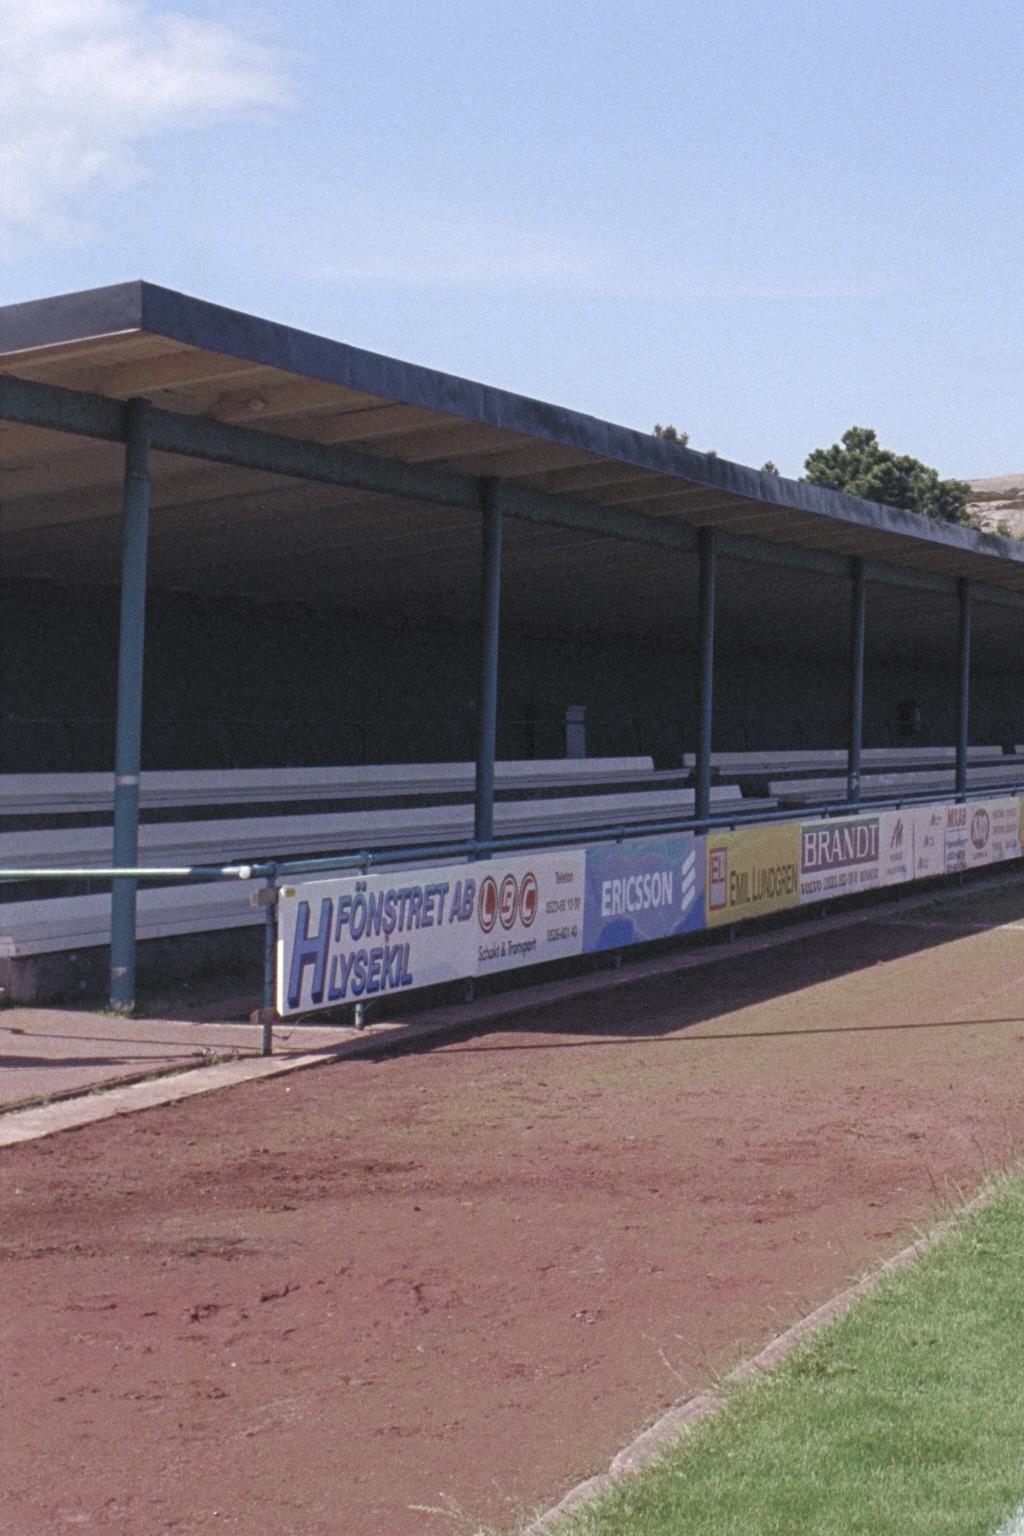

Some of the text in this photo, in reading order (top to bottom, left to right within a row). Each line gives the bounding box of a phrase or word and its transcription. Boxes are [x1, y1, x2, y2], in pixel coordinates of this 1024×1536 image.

[804, 824, 878, 868] BRANDT
[601, 871, 673, 917] ERICSSON
[729, 870, 750, 907] EMIL
[752, 863, 798, 901] LUNDGREN
[288, 879, 476, 1009] H FÖNSTRET AB
[478, 938, 537, 962] Schakt & Transport
[328, 943, 413, 1001] LYSEKIL
